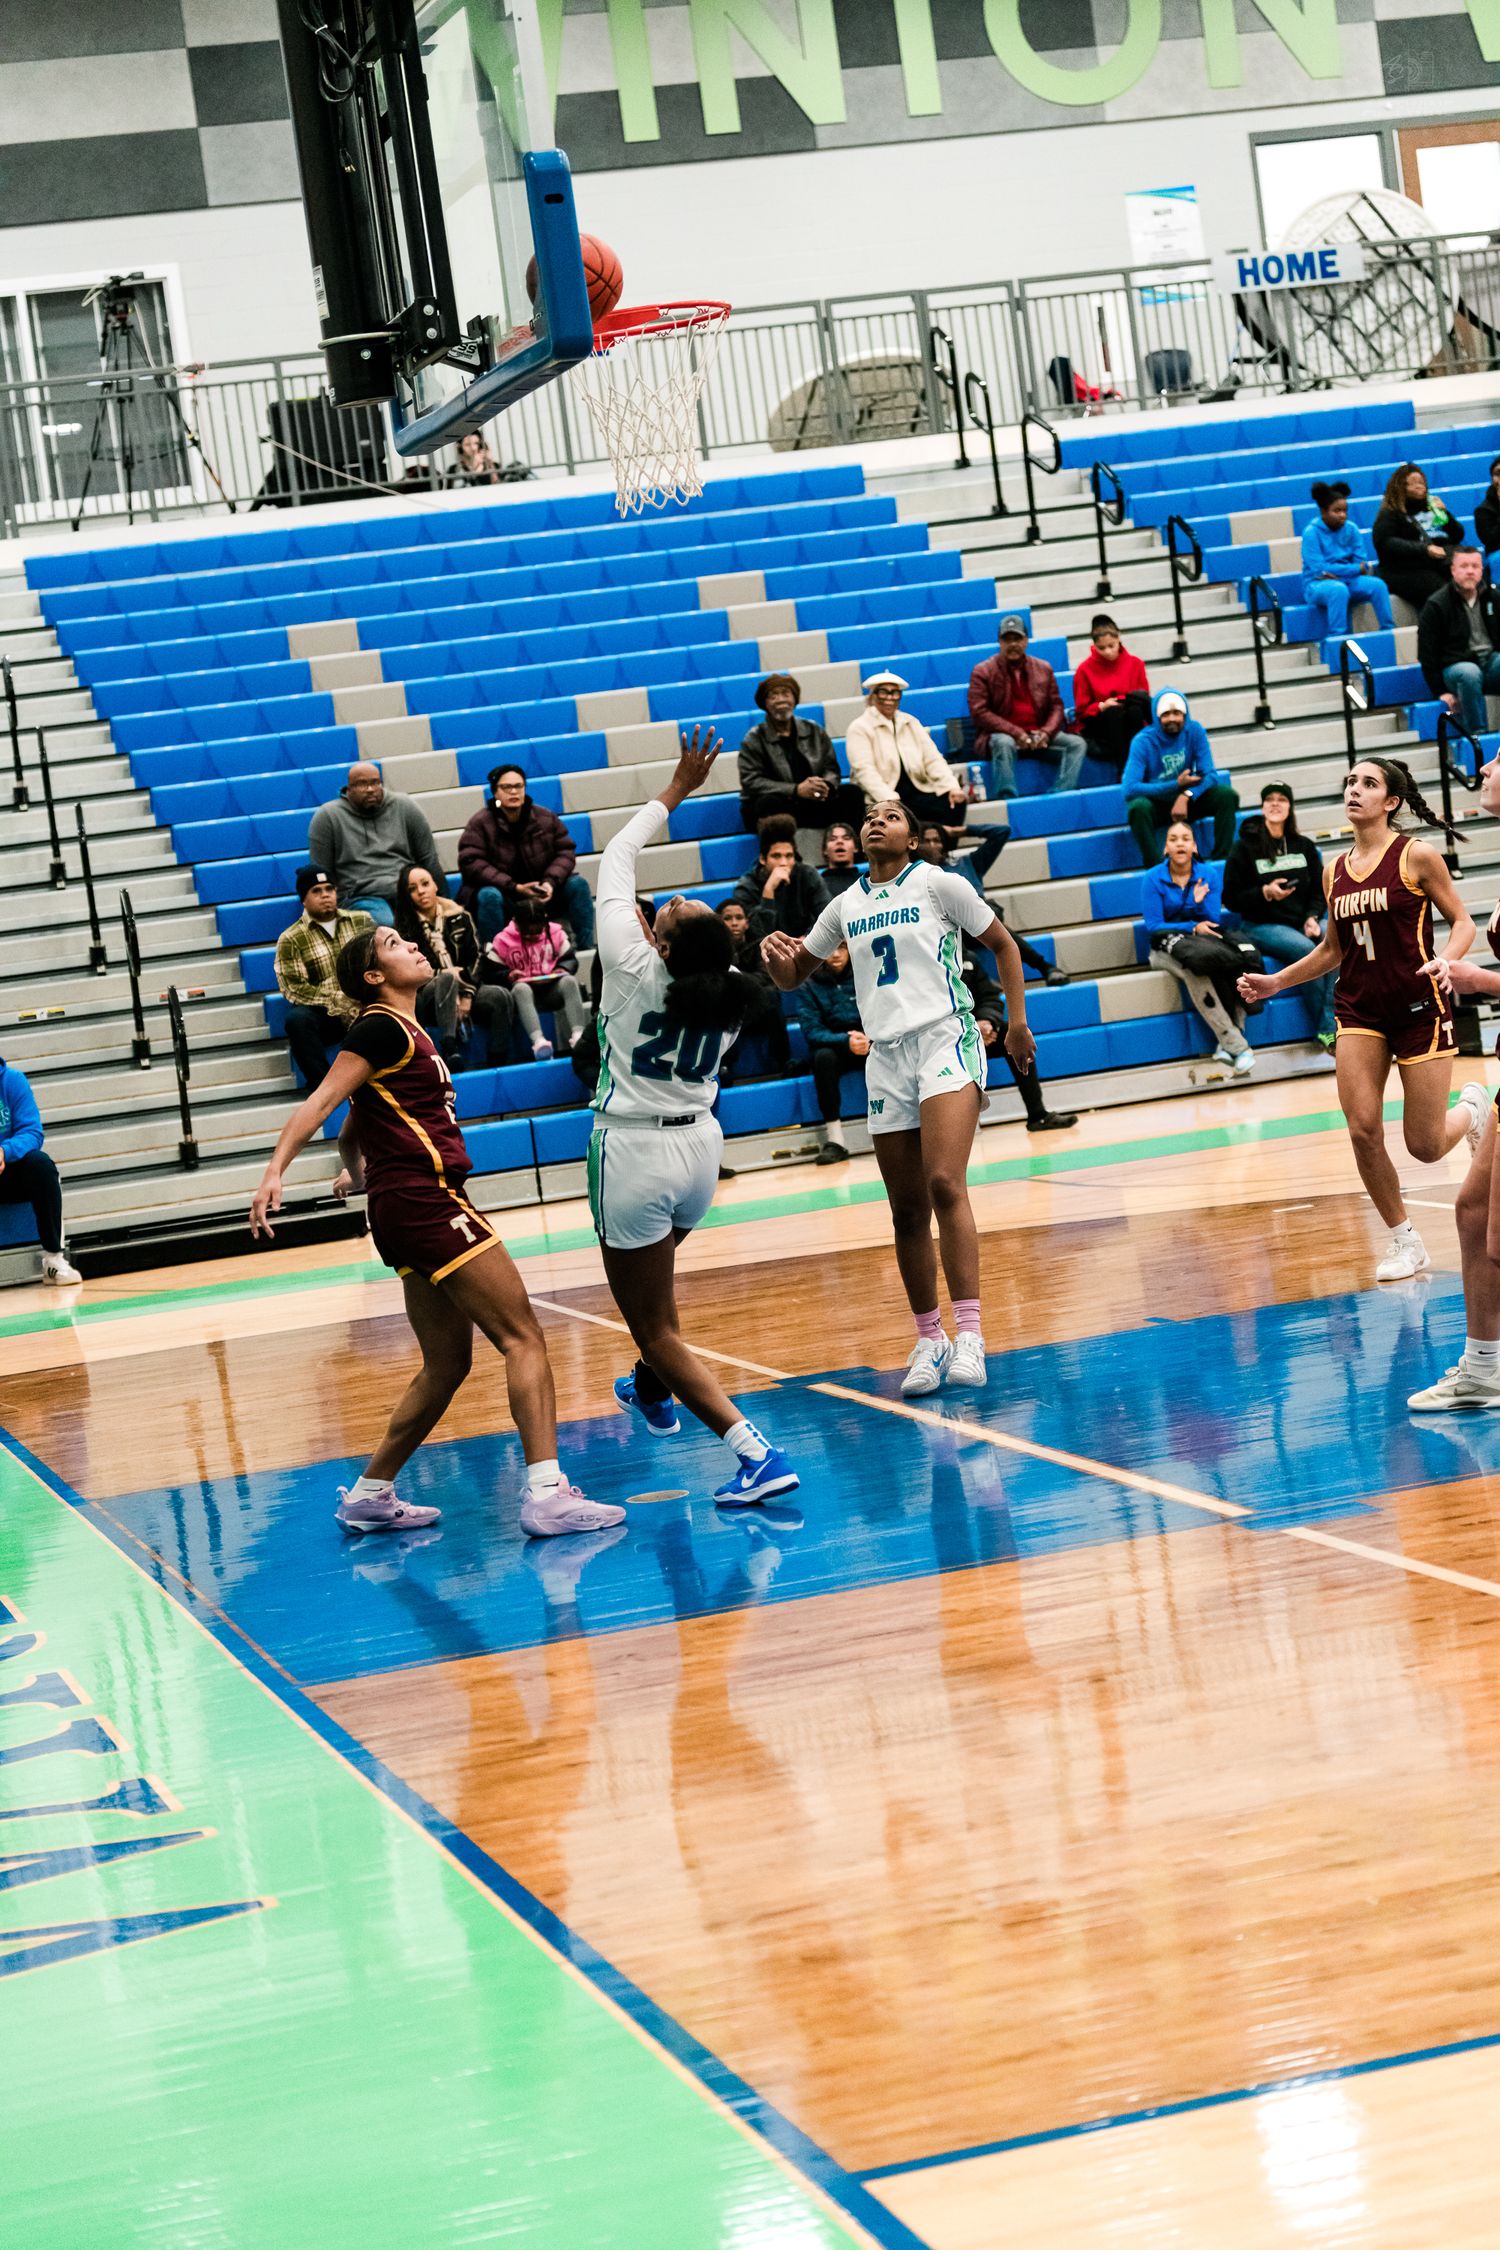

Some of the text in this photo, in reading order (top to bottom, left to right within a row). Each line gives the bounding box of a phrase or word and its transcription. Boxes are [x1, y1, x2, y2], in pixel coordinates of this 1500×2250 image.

[437, 0, 1342, 150] INO
[1238, 249, 1340, 287] HOME
[847, 907, 920, 938] WARRIORS
[1334, 887, 1389, 920] TURPIN
[1352, 920, 1376, 961] 4
[871, 934, 899, 987] 3
[631, 1010, 723, 1084] 20
[1441, 1020, 1454, 1045] T
[450, 1213, 477, 1243] T
